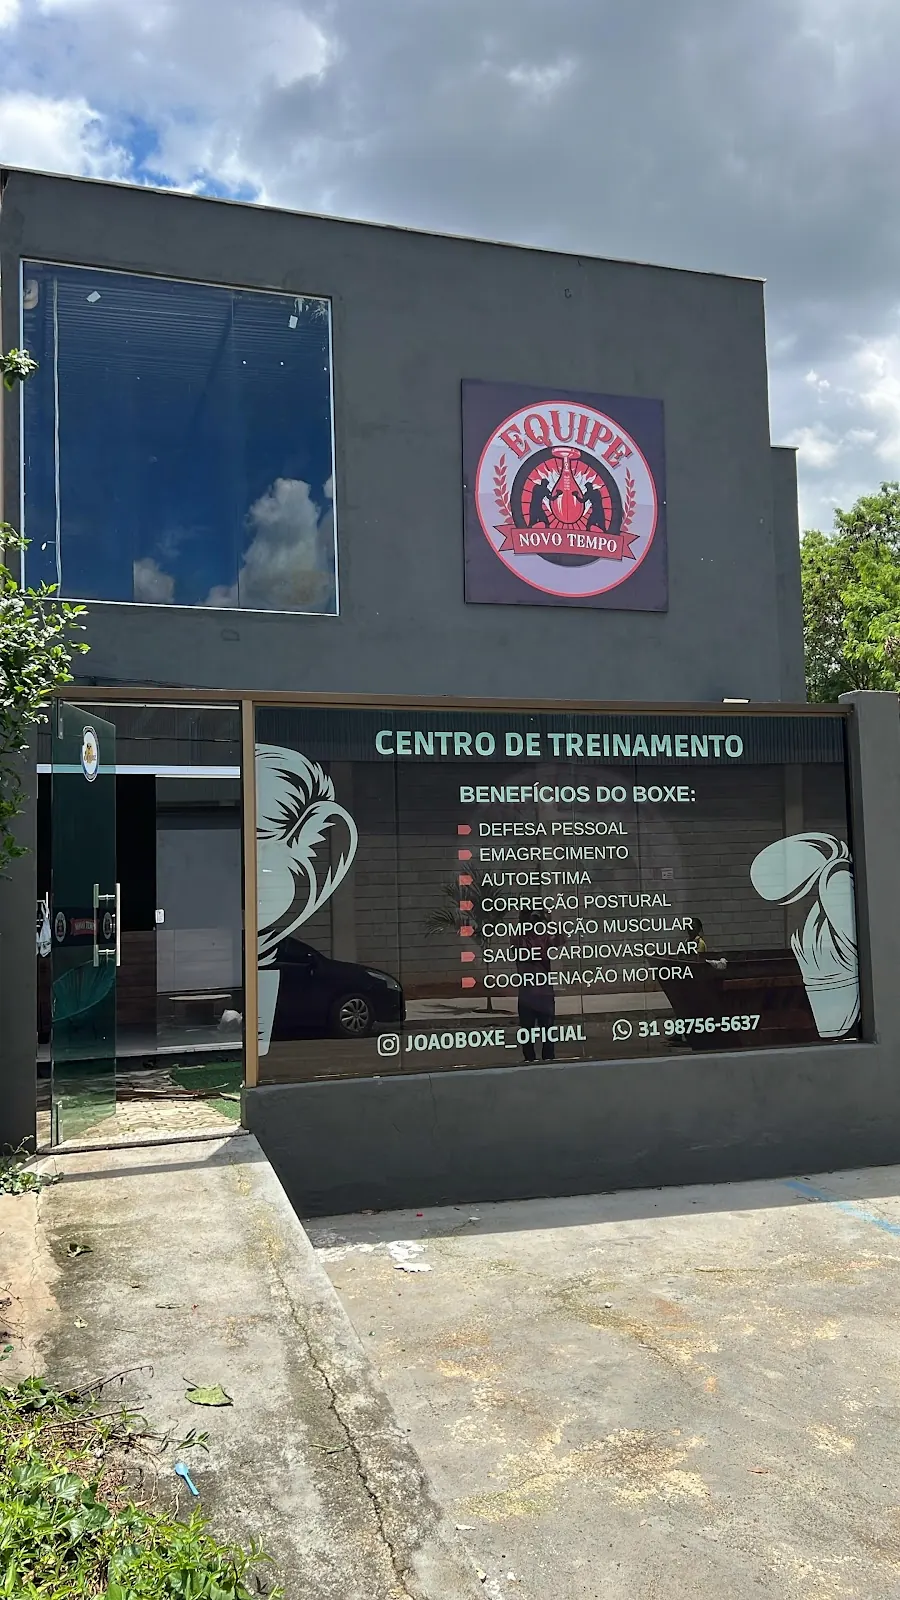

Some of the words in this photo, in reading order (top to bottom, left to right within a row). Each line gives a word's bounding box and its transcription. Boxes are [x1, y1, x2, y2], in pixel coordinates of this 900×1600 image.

[499, 410, 633, 468] EQUIPE
[519, 532, 562, 547] NOVO
[566, 534, 617, 552] TEMPO
[375, 730, 496, 756] CENTRO
[505, 732, 541, 757] DE
[547, 733, 744, 758] TREINAMENTO
[459, 782, 590, 803] BENEFÍCIOS
[597, 785, 627, 803] DO
[633, 785, 696, 803] BOXE:
[479, 822, 547, 837] DEFESA
[551, 821, 628, 836] PESSOAL
[479, 846, 629, 862] EMAGRECIMENTO
[481, 871, 592, 887] AUTOESTIMA
[481, 895, 579, 913] CORREÇÃO
[584, 893, 672, 908] POSTURAL
[481, 918, 599, 938] COMPOSIÇÃO
[603, 917, 694, 933] MUSCULAR
[482, 944, 542, 963] SAÚDE
[547, 941, 698, 961] CARDIOVASCULAR
[483, 966, 618, 989] COORDENAÇÃO
[622, 966, 694, 983] MOTORA
[638, 1021, 660, 1037] 31
[664, 1014, 761, 1036] 98756-5637
[405, 1025, 587, 1052] JOAOBOXE_OFICIAL
